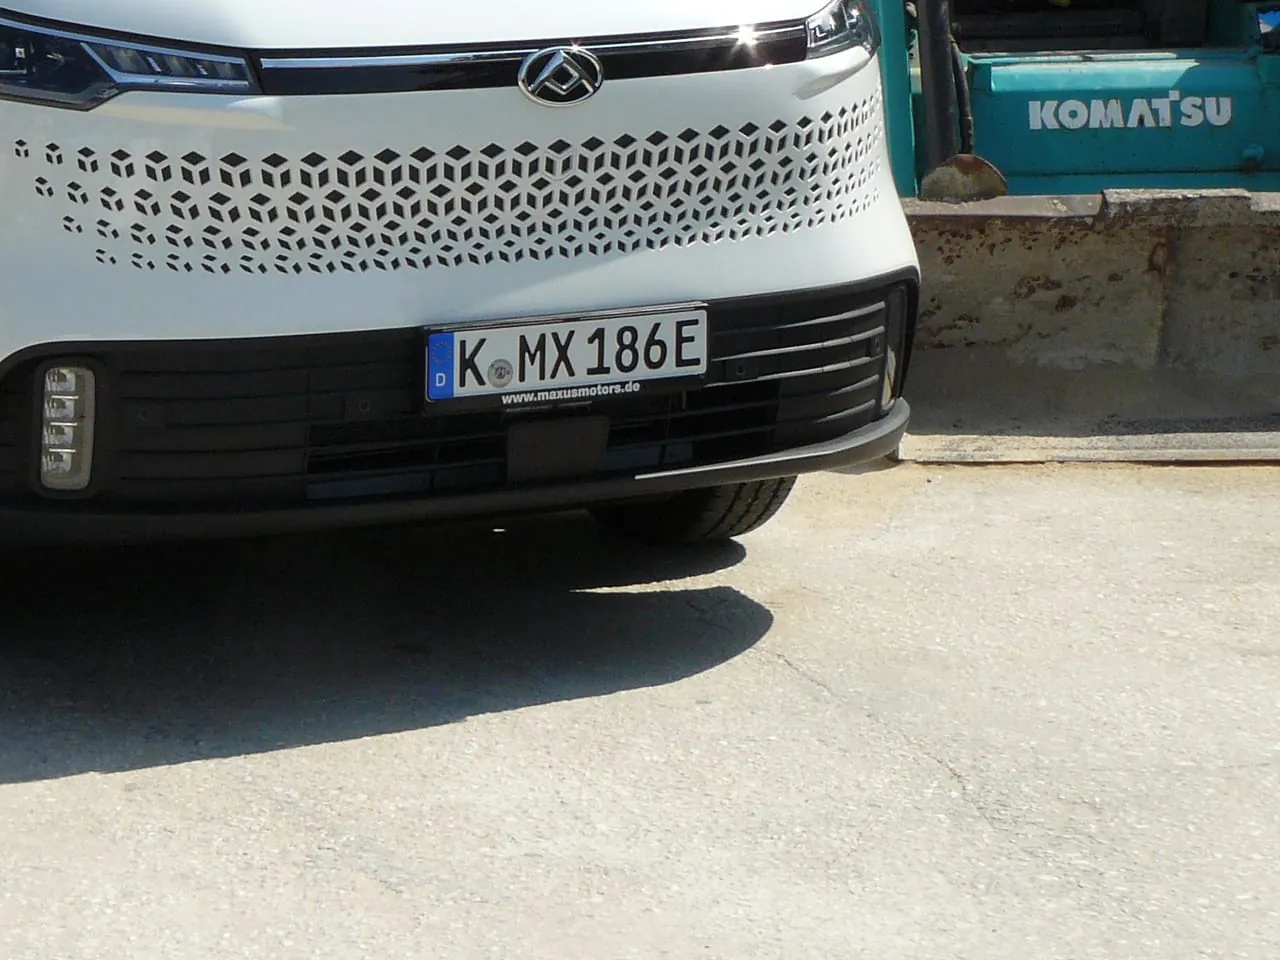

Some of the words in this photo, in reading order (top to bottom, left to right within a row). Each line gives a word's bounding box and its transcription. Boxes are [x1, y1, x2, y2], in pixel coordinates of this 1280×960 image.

[1028, 89, 1233, 130] KOMATSU
[435, 373, 446, 388] D
[502, 380, 641, 405] www.maxusmotors.de
